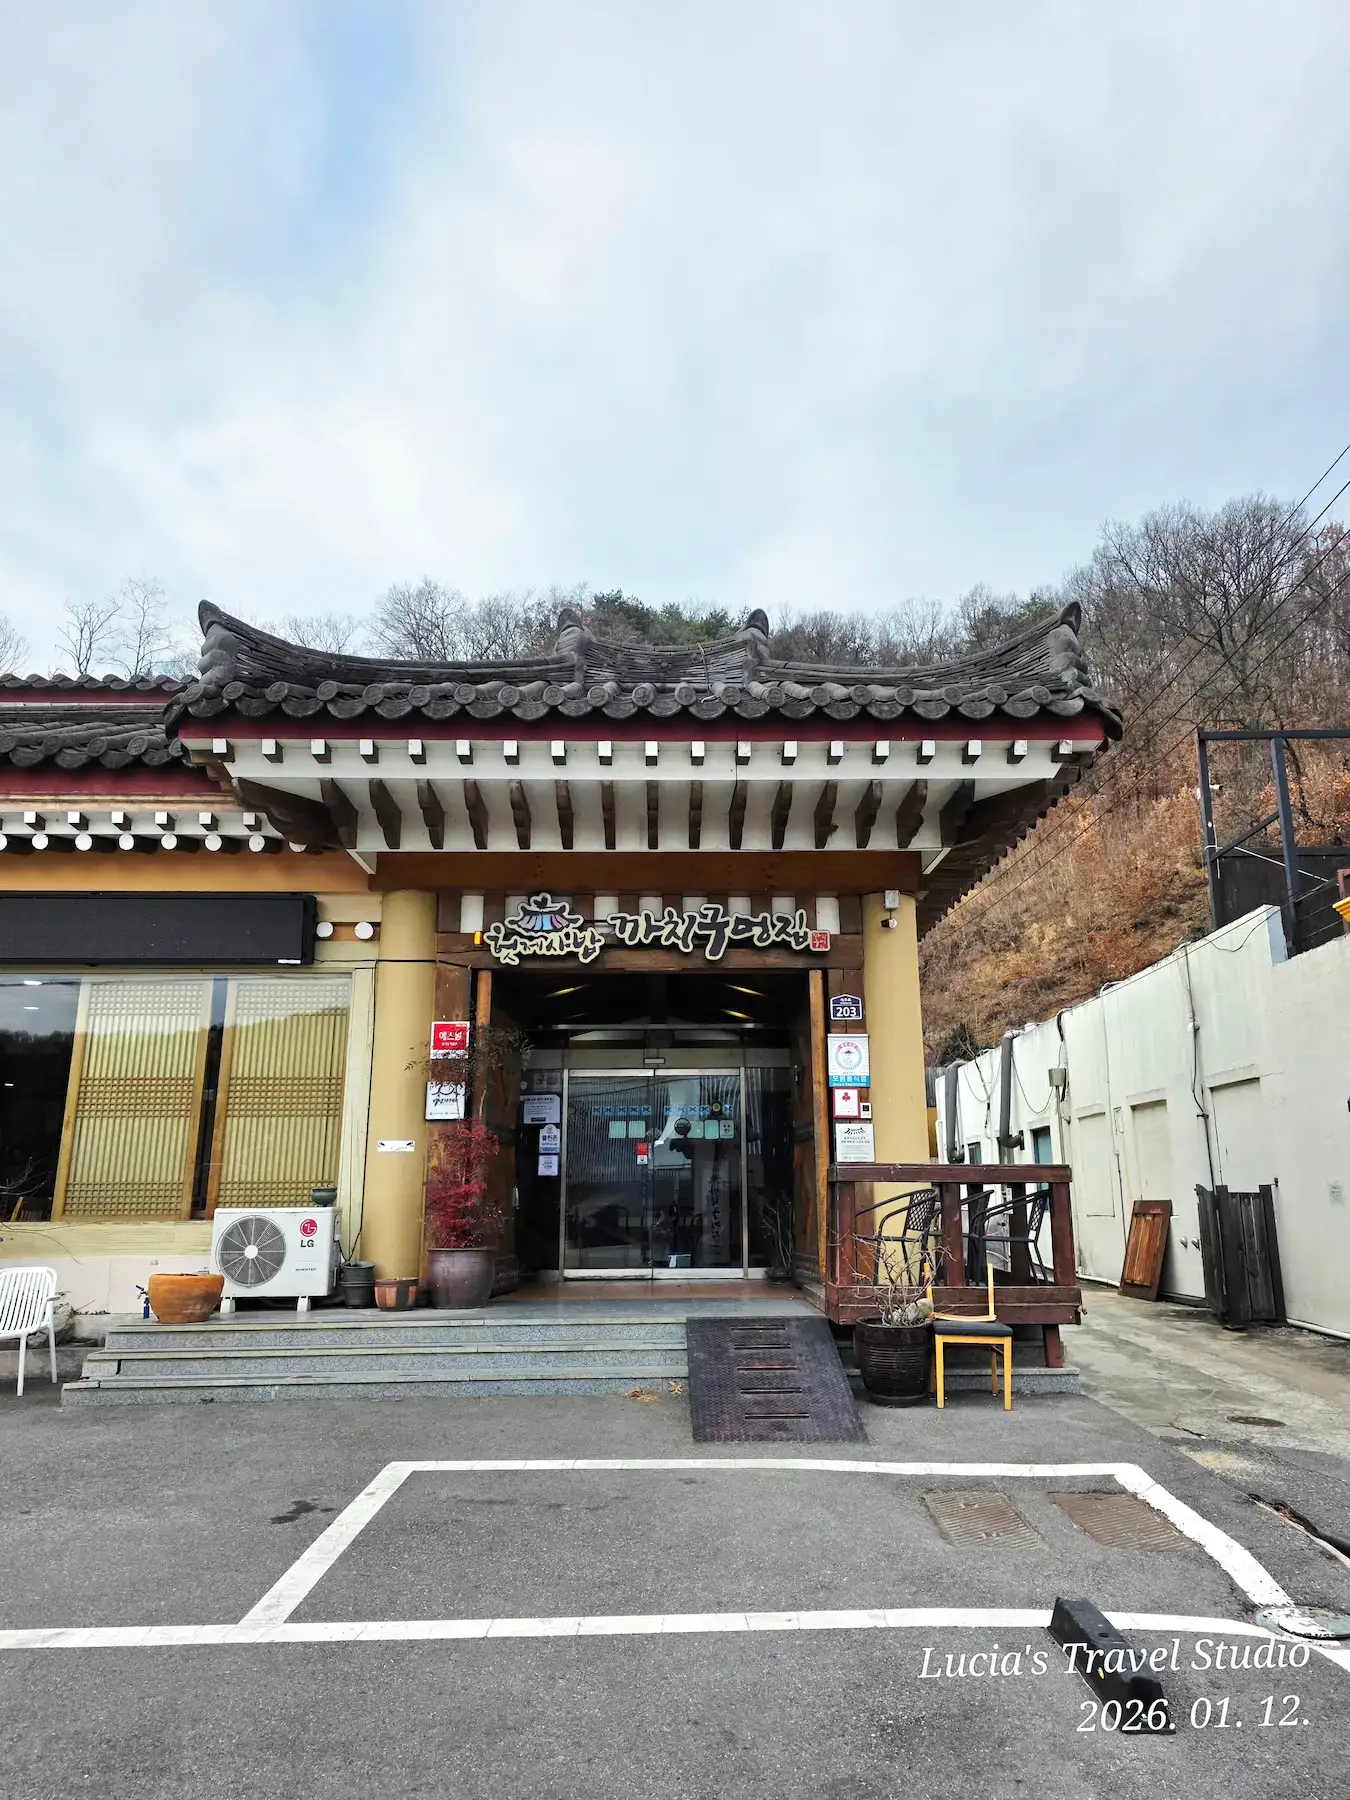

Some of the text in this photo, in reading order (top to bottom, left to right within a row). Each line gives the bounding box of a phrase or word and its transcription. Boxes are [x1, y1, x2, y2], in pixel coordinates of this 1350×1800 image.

[485, 895, 810, 964] 헛제사밥 까치구멍집
[836, 1007, 857, 1017] 203
[300, 1239, 315, 1248] LG
